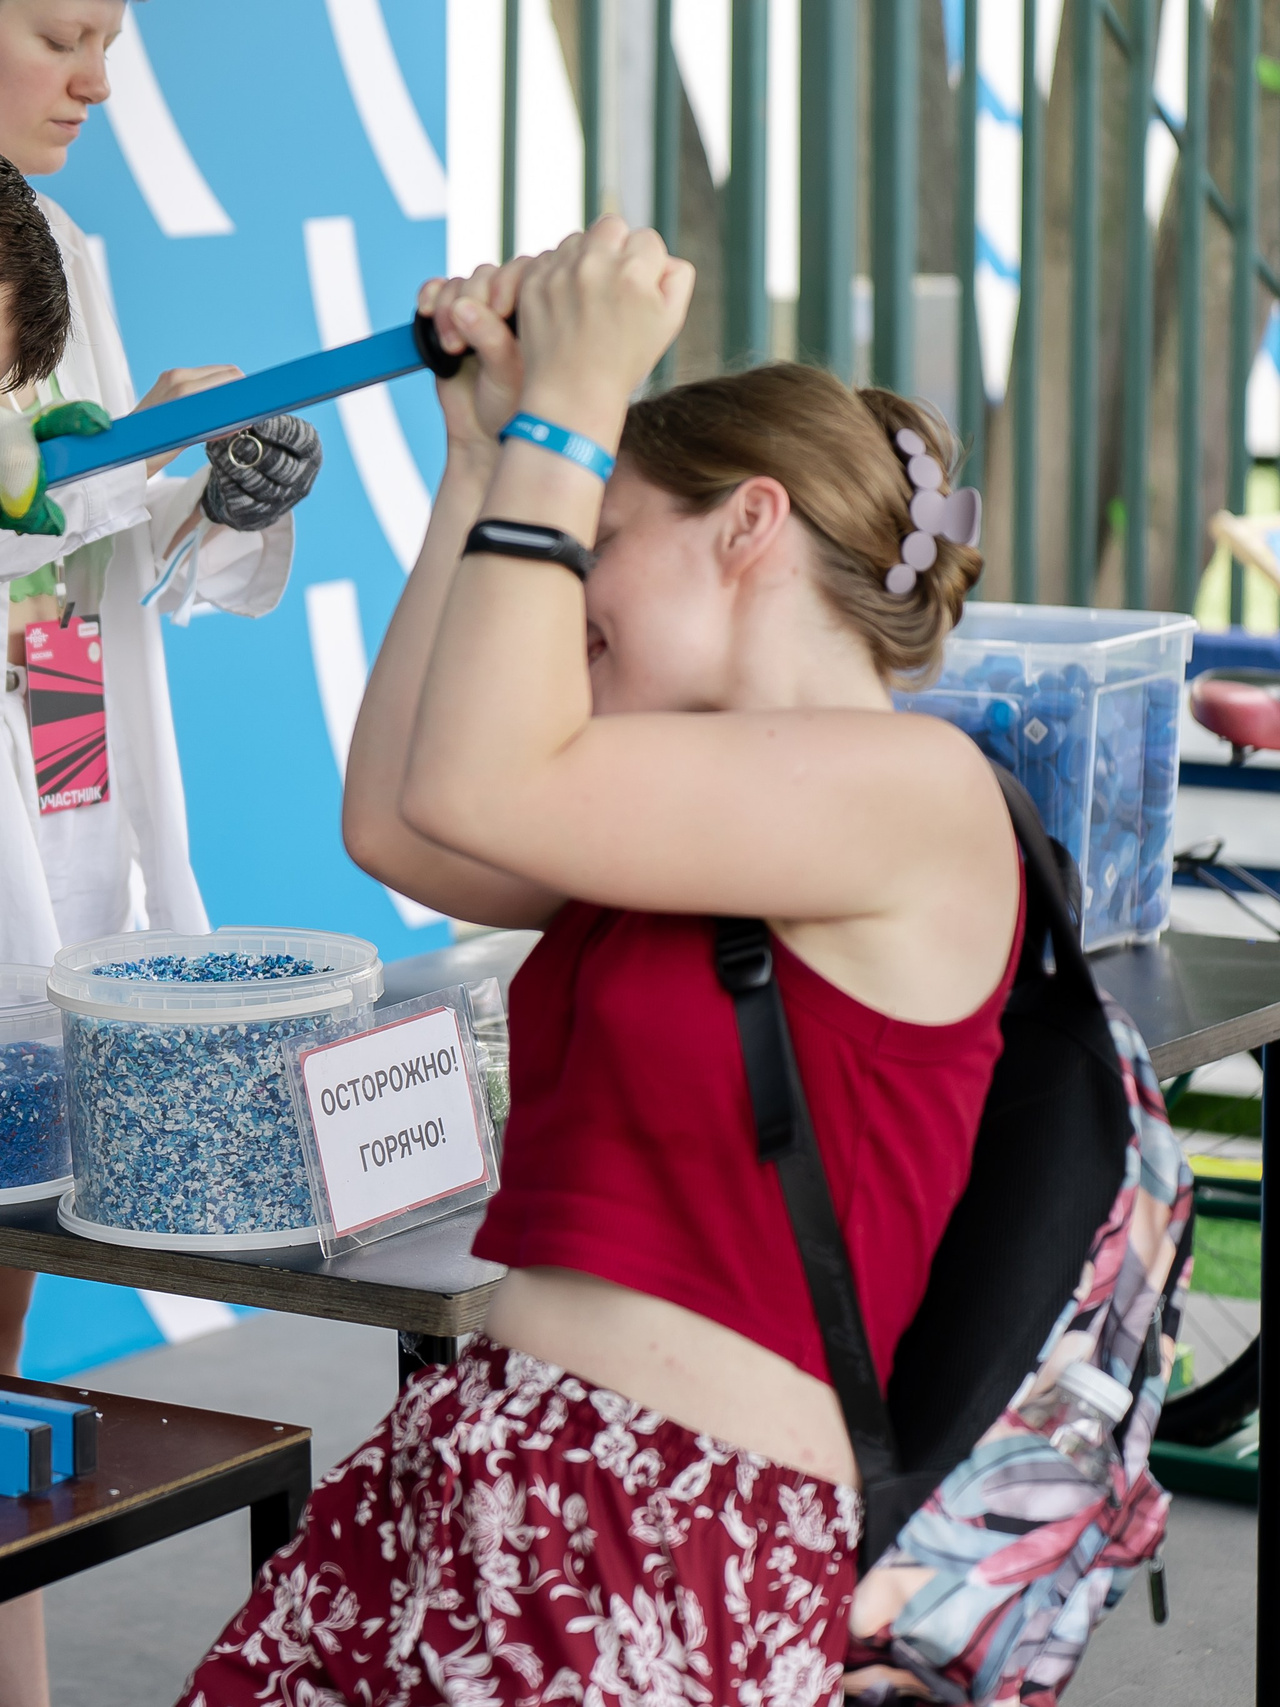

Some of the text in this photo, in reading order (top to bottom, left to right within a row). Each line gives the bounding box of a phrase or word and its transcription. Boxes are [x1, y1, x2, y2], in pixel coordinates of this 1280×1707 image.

[40, 786, 102, 810] УЧАСТНИК
[320, 1046, 459, 1116] ОСТОРОЖНО!
[358, 1117, 447, 1172] ГОРЯЧО!
